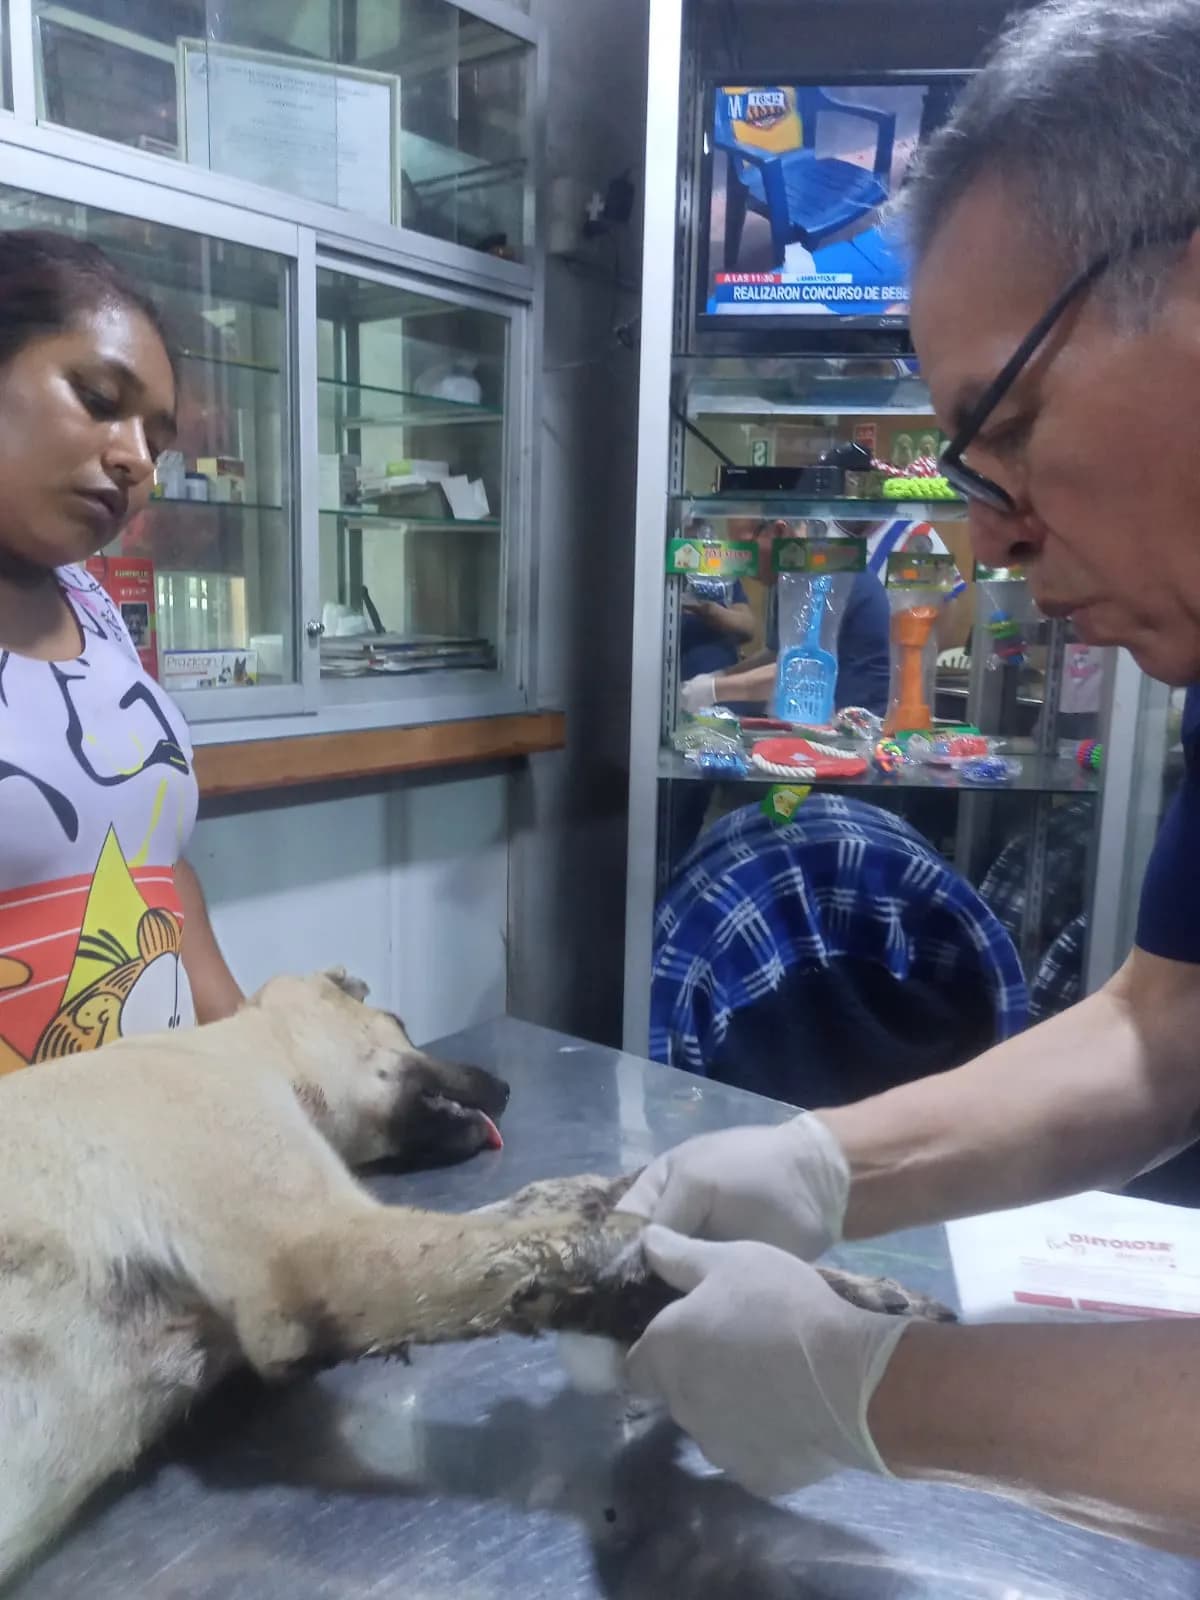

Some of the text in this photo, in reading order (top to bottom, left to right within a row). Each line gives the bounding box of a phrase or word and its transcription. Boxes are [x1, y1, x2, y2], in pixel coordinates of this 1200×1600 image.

[724, 274, 732, 283] A
[733, 274, 749, 283] LAS
[733, 286, 800, 300] REALIZARON
[802, 286, 862, 300] CONCURSO
[864, 287, 880, 300] DE
